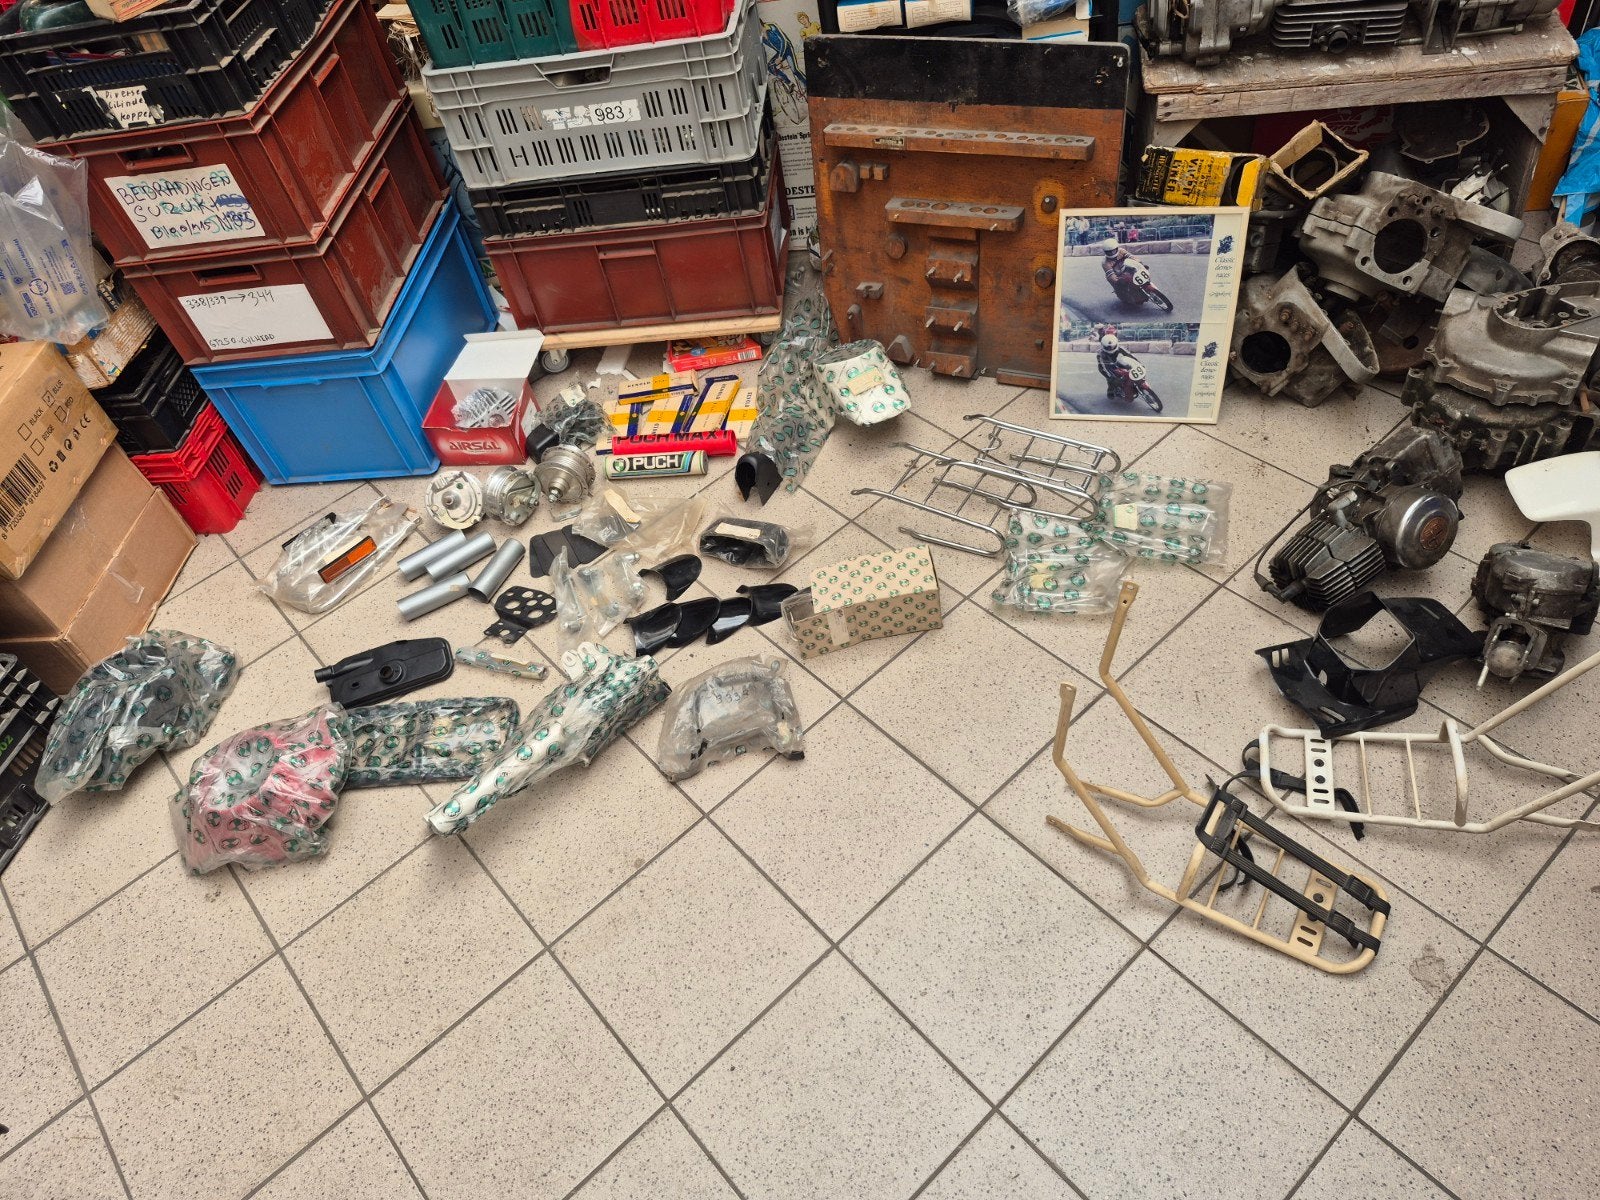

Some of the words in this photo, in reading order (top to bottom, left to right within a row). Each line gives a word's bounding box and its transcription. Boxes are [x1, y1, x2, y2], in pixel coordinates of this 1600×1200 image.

[109, 98, 143, 109] Cilinde
[595, 105, 625, 121] 983
[1166, 160, 1182, 192] LINER
[1134, 270, 1150, 284] 68
[186, 295, 227, 309] 338/339
[248, 289, 275, 307] 344
[1131, 366, 1144, 379] 69
[29, 407, 44, 426] BLACK
[52, 380, 64, 395] BLUE
[42, 424, 55, 441] BEIGE
[64, 396, 74, 408] RED
[449, 441, 501, 451] AIRSAL
[632, 454, 679, 470] PUCH
[8, 507, 27, 531] 720387
[28, 481, 46, 504] 918447
